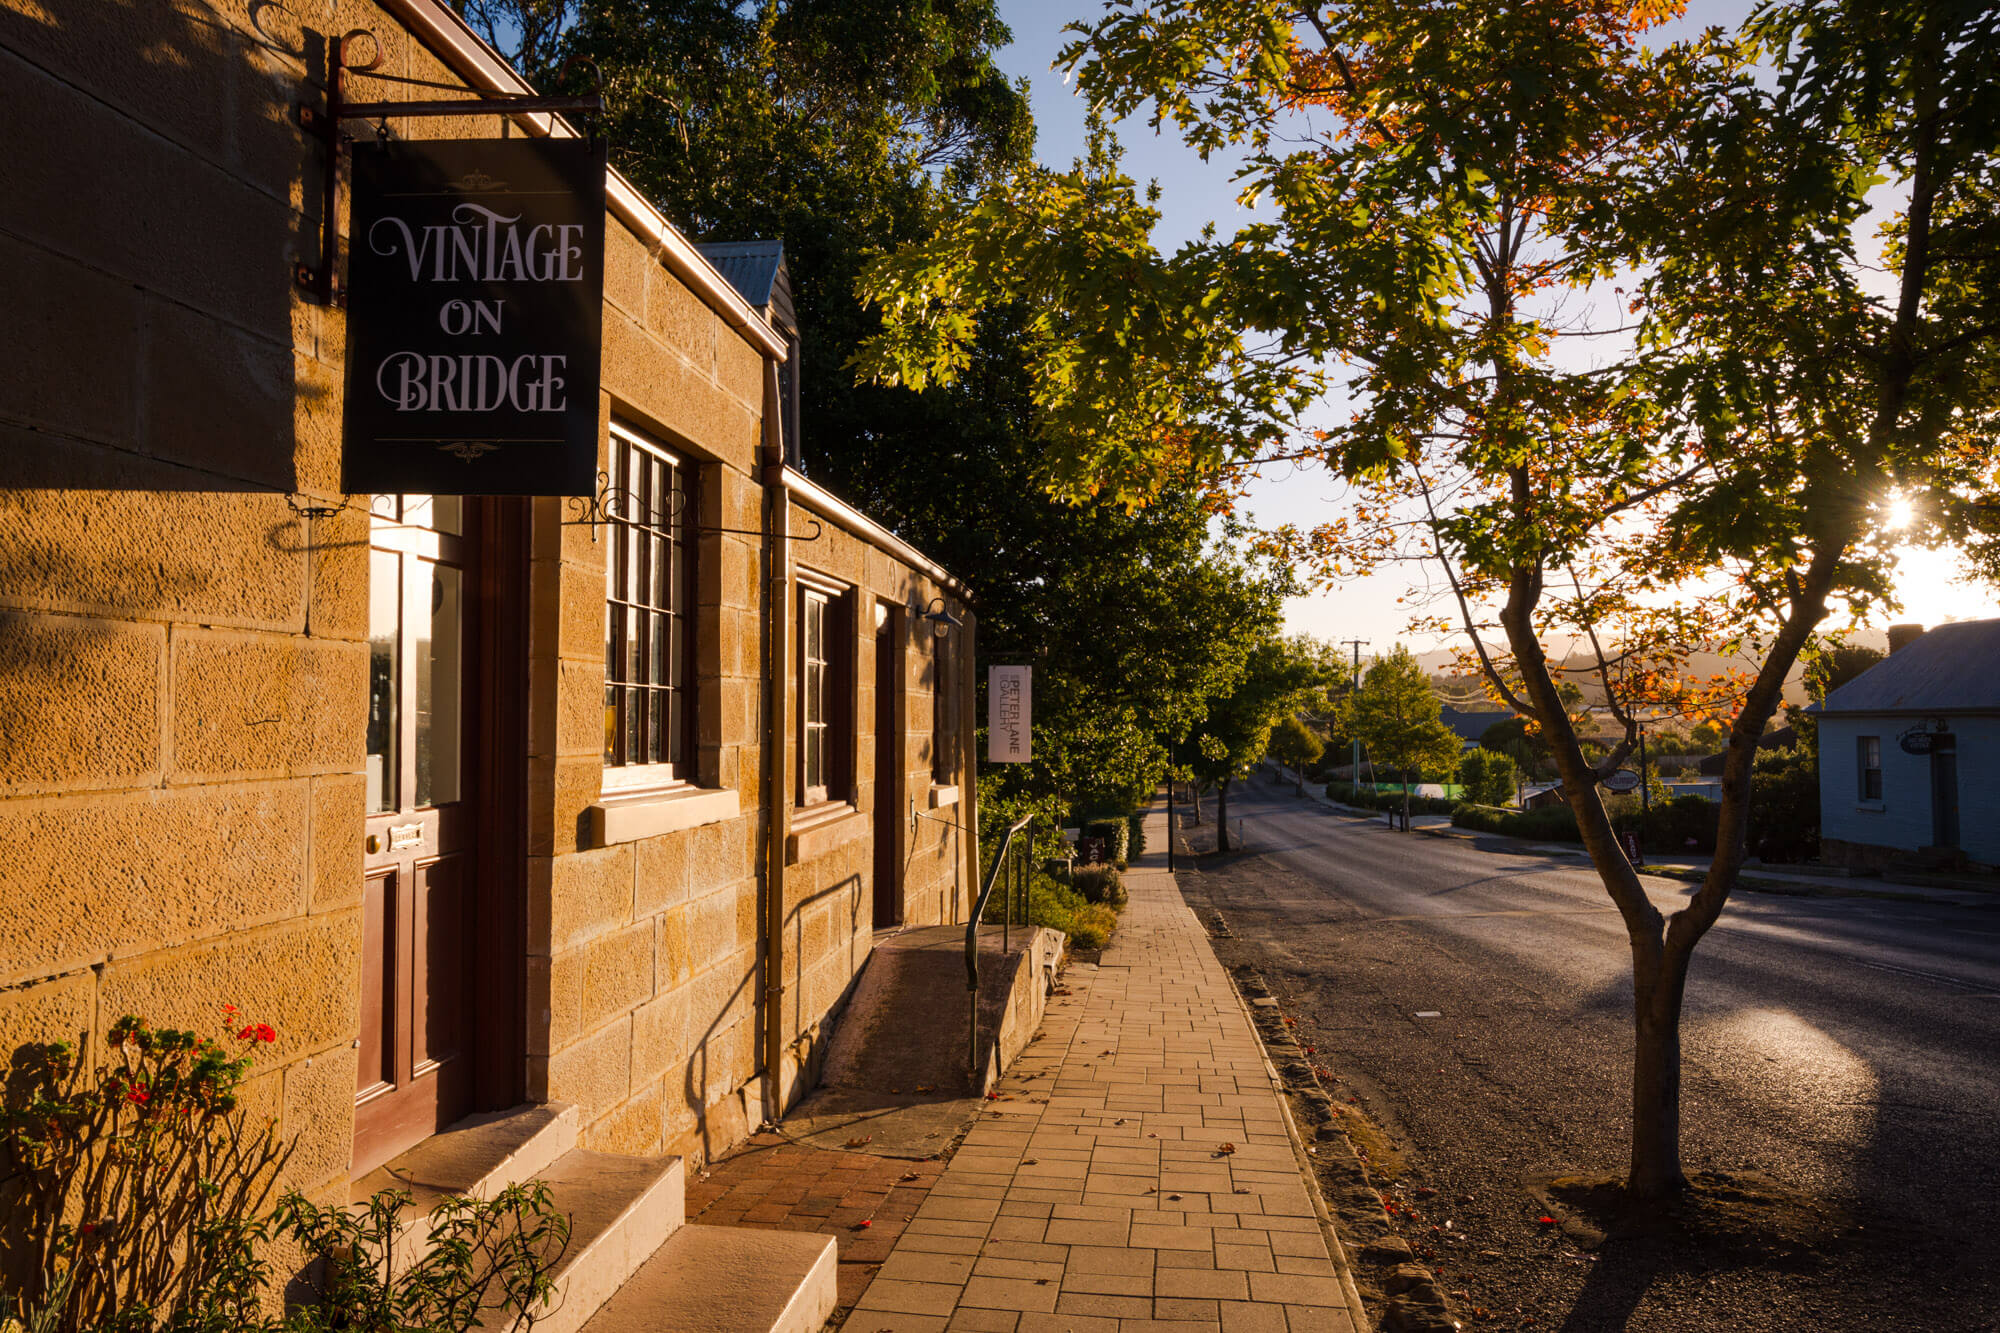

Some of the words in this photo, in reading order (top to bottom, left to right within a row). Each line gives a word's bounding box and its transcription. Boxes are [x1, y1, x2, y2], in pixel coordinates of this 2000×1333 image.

[368, 203, 584, 282] VINTAGE
[439, 299, 506, 336] ON
[376, 351, 567, 413] BRIDGE
[999, 679, 1010, 732] GALLERY
[1009, 680, 1020, 720] PETER
[1009, 722, 1020, 754] LANE
